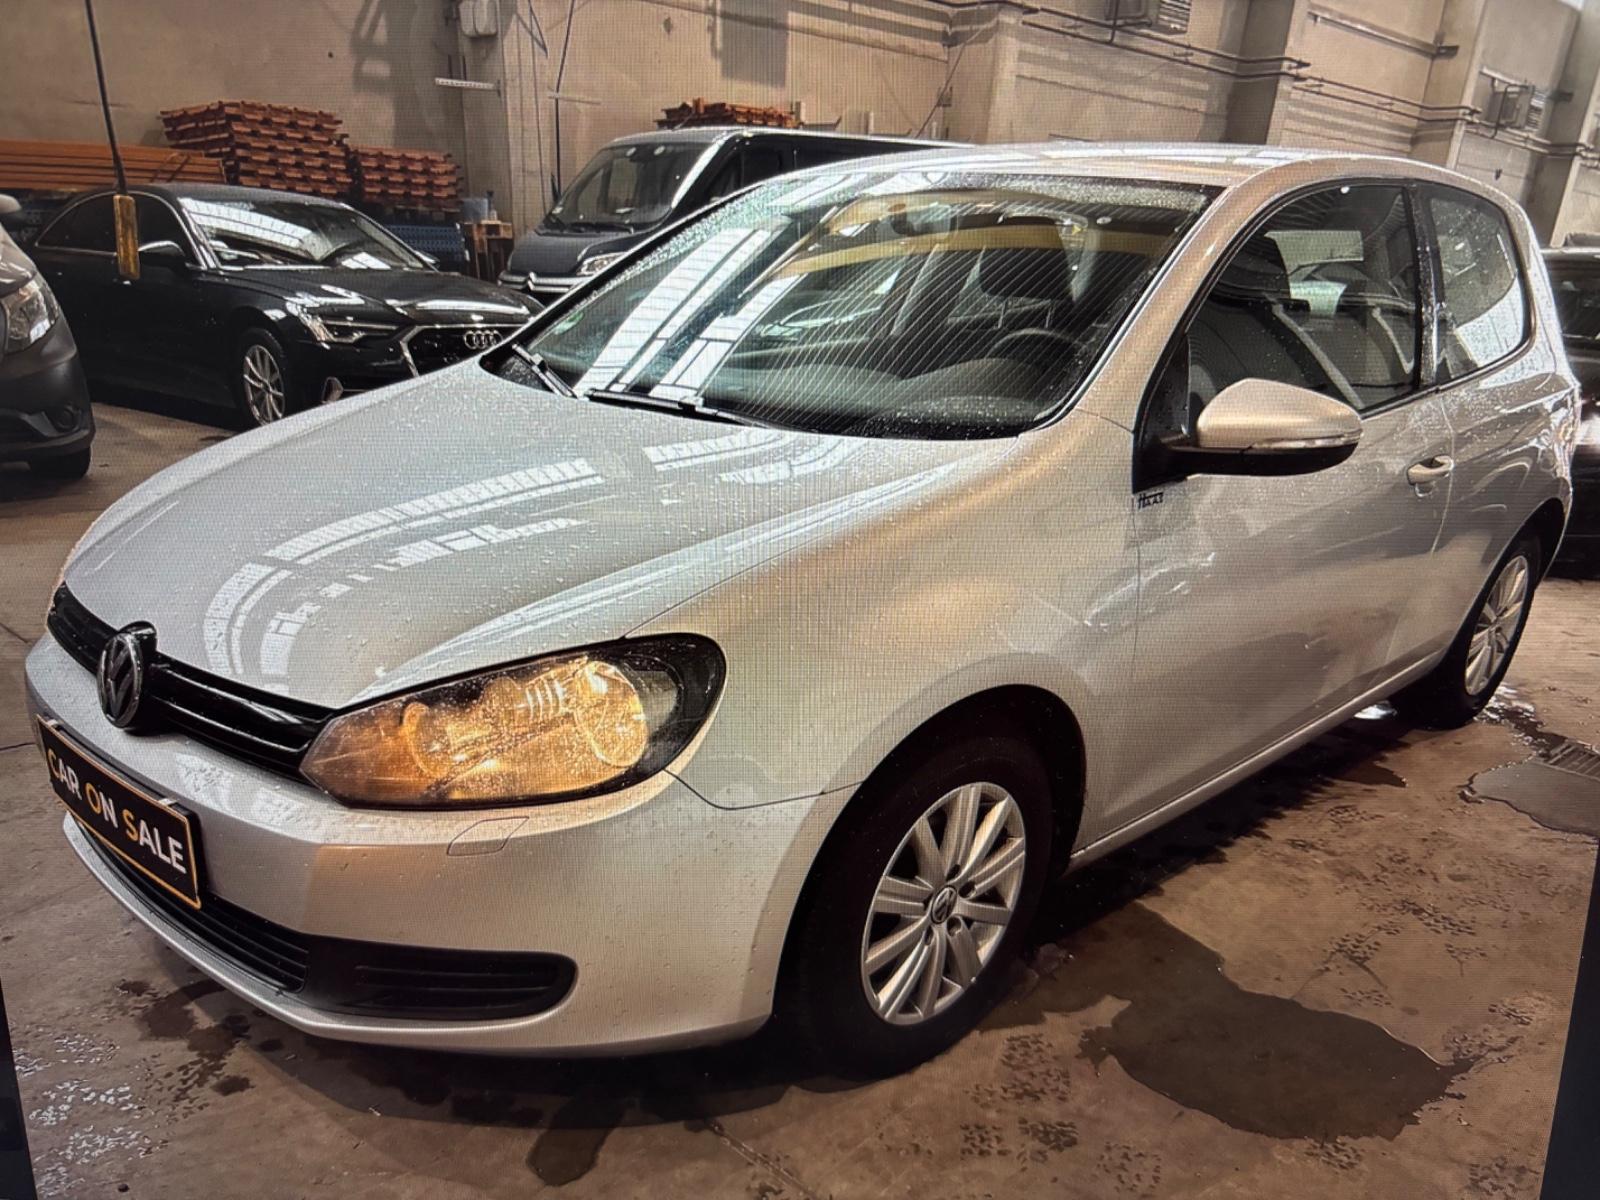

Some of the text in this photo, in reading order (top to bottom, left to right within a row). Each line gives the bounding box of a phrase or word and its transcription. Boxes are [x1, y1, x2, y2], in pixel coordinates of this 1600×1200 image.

[47, 748, 188, 875] CAR ON SALE
